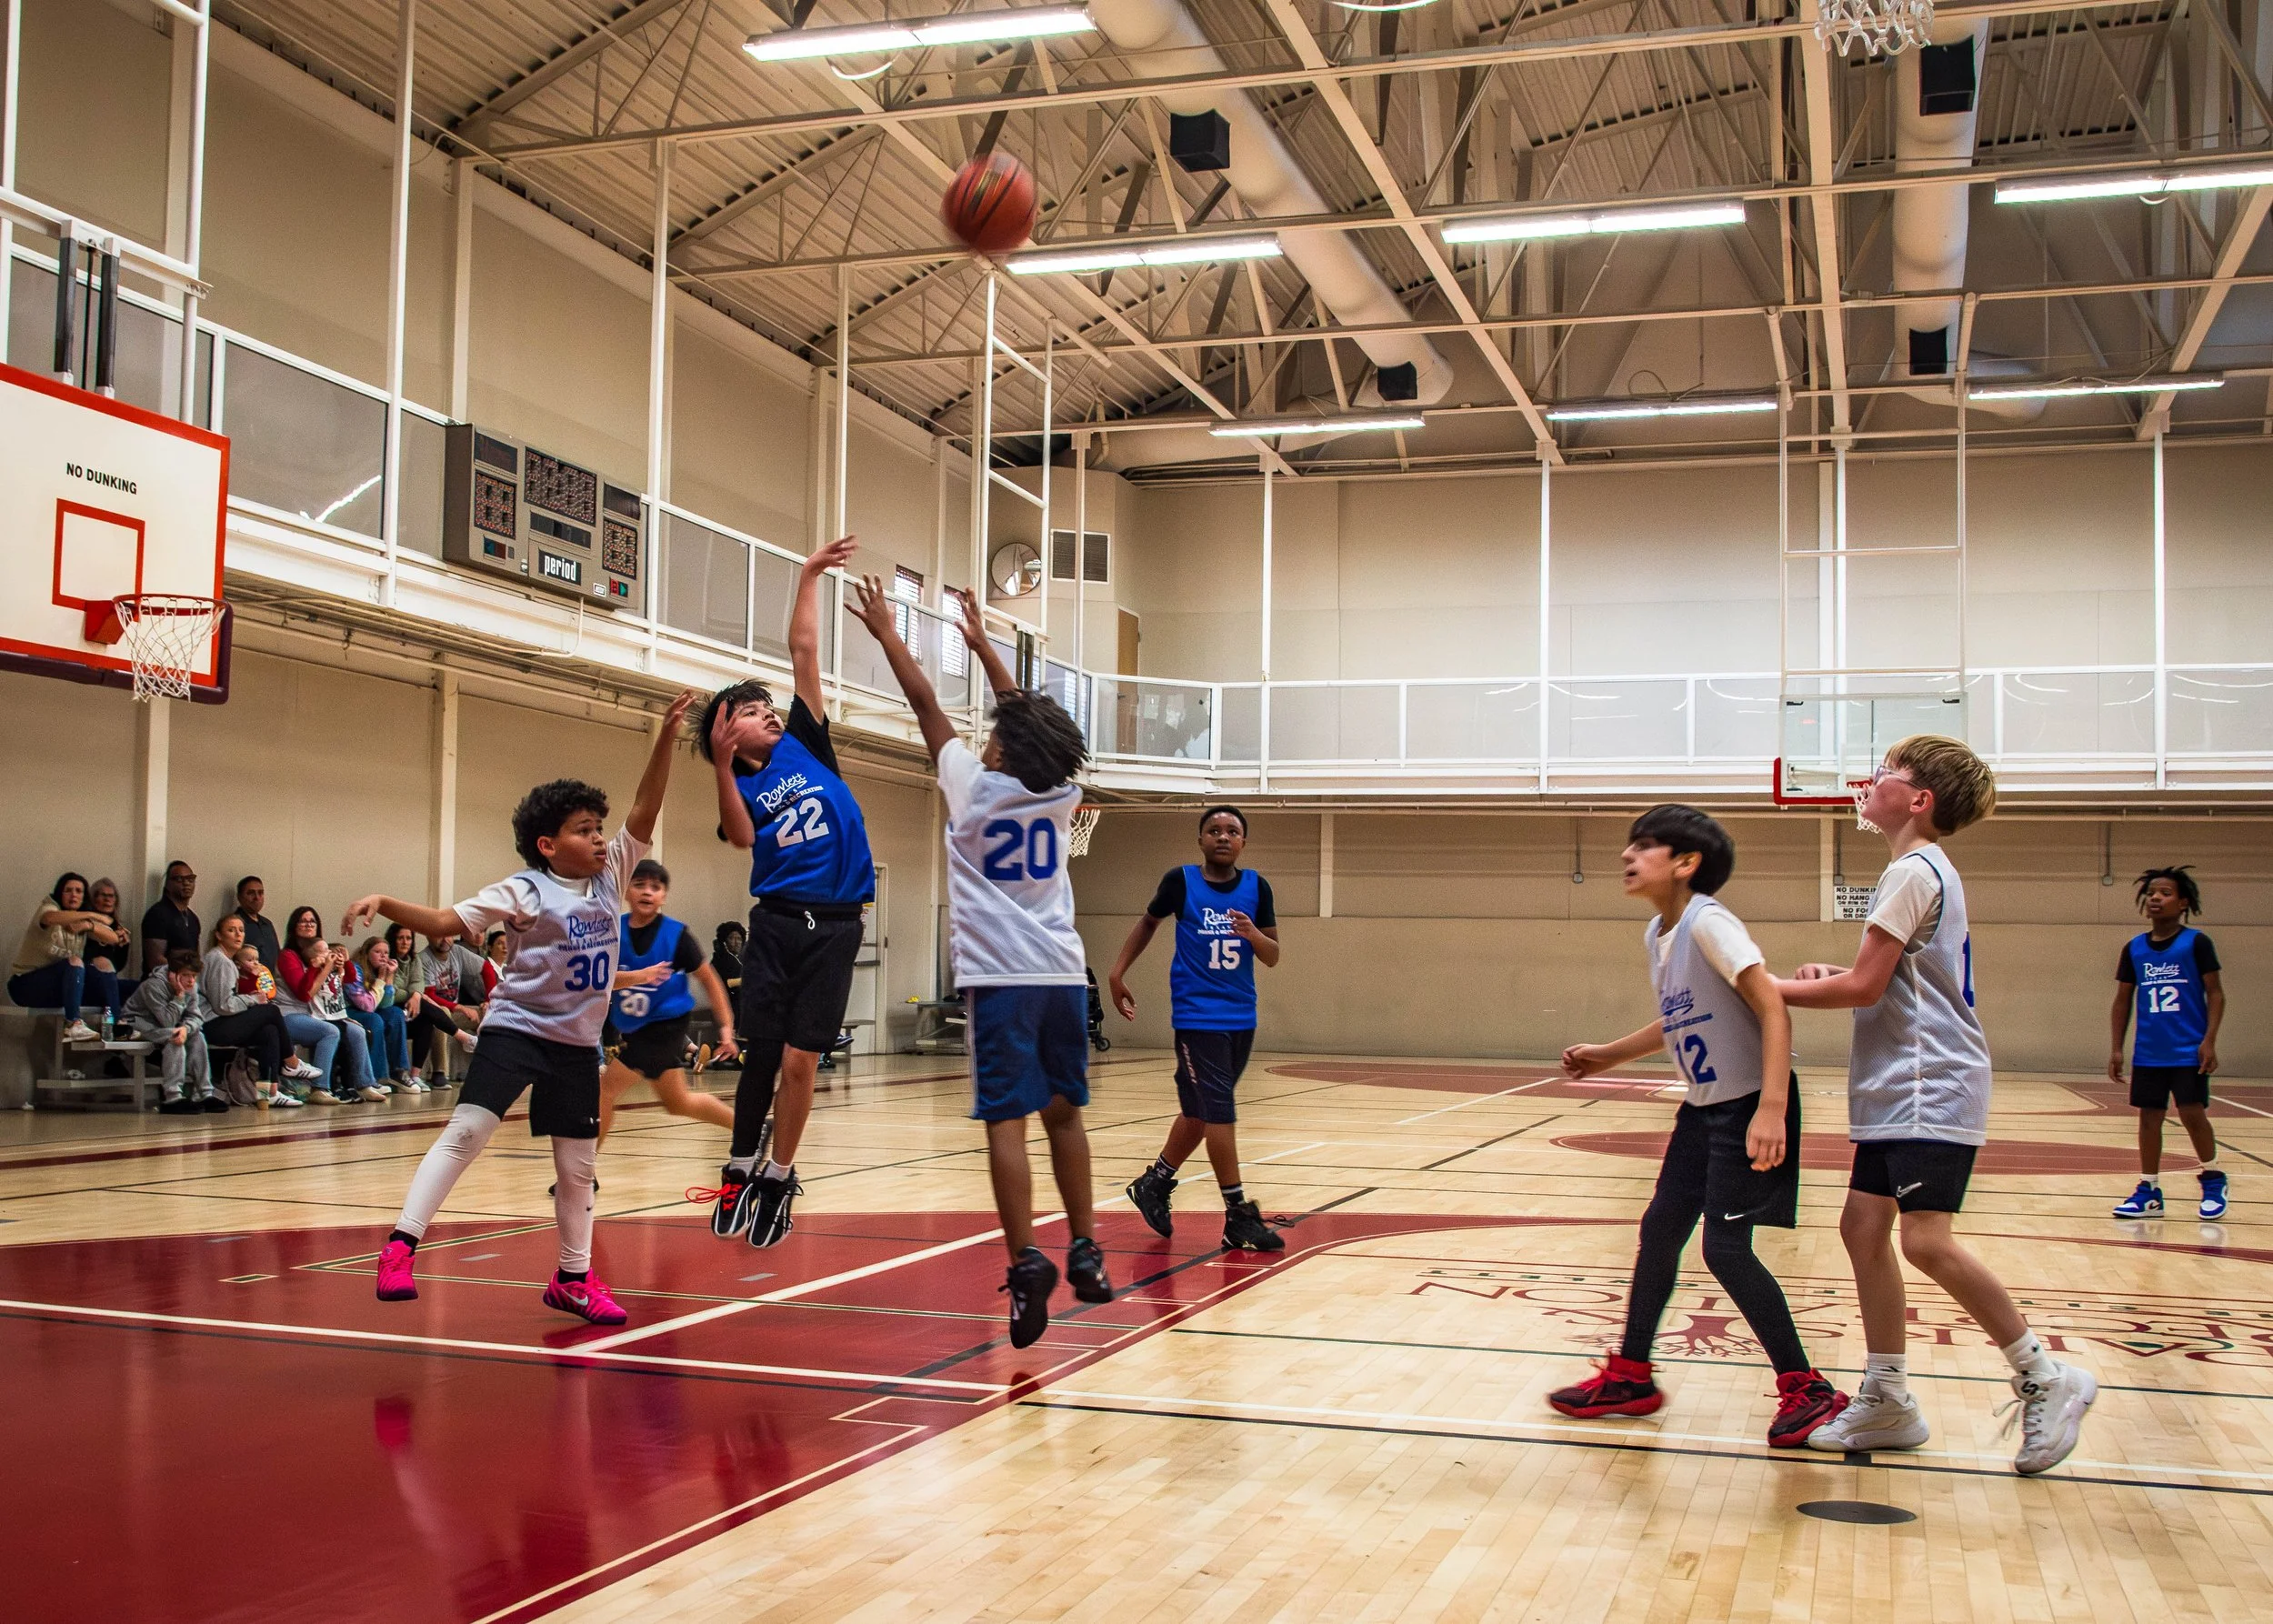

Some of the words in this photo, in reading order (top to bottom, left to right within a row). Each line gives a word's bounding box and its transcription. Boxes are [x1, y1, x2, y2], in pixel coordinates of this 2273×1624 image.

[66, 462, 83, 478] NO
[86, 468, 137, 495] DUNKING
[545, 555, 576, 582] period
[756, 772, 808, 814] Rowlett
[774, 797, 829, 847] 22
[984, 817, 1058, 881] 20
[565, 951, 610, 992] 30
[1208, 938, 1242, 970] 15
[2148, 986, 2181, 1013] 12
